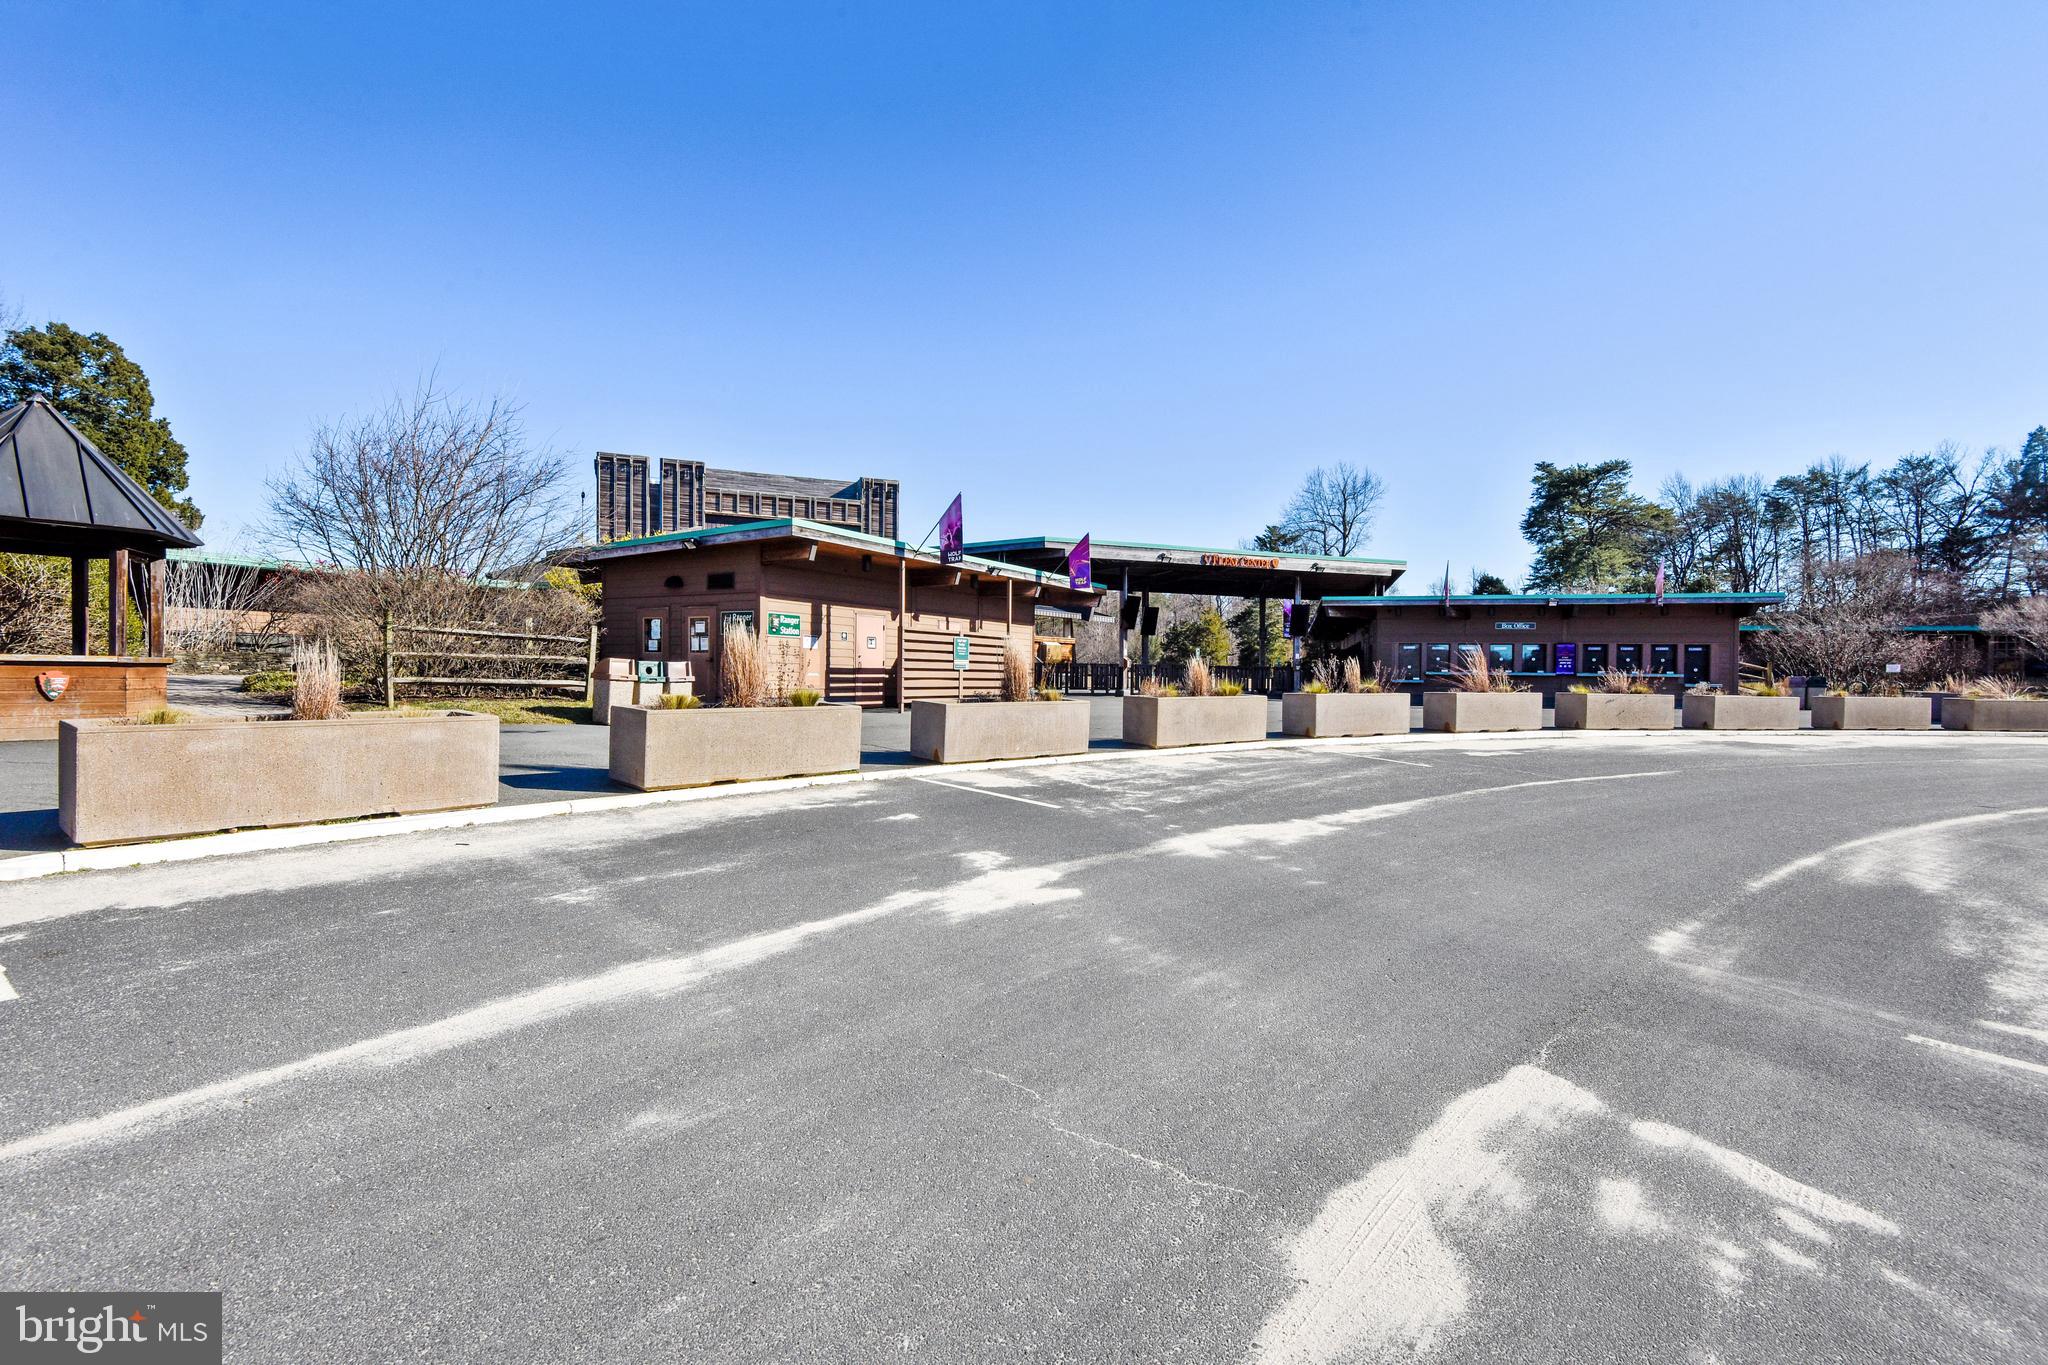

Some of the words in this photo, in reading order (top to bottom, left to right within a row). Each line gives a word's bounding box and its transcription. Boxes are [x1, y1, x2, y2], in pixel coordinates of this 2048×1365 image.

[1241, 556, 1271, 569] CENTER
[779, 615, 800, 626] Ranger
[779, 626, 800, 636] Station
